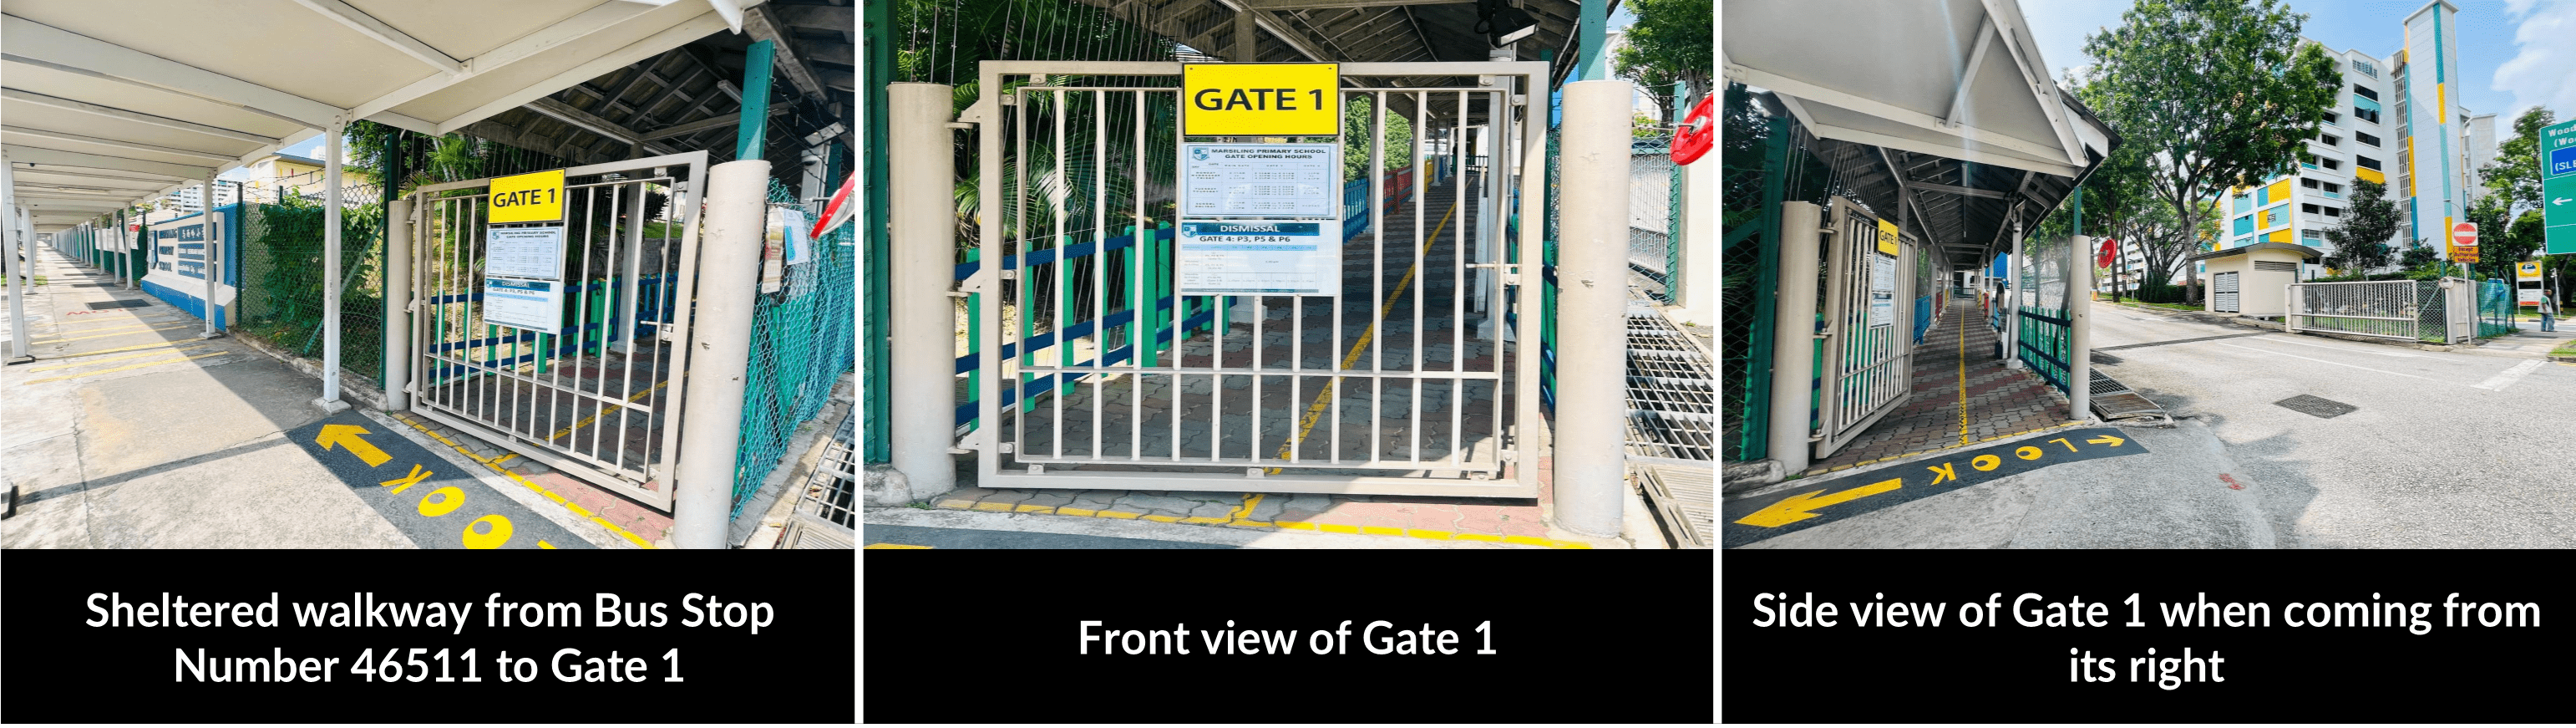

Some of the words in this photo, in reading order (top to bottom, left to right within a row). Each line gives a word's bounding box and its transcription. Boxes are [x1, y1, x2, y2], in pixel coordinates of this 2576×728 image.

[1194, 89, 1296, 110] GATE
[1308, 89, 1322, 110] 1
[2553, 137, 2576, 147] (Wo
[493, 189, 542, 207] GATE
[547, 188, 555, 203] 1
[1220, 225, 1280, 233] DISMISSAL
[1879, 230, 1894, 245] GATE
[1926, 436, 2079, 486] LOOK
